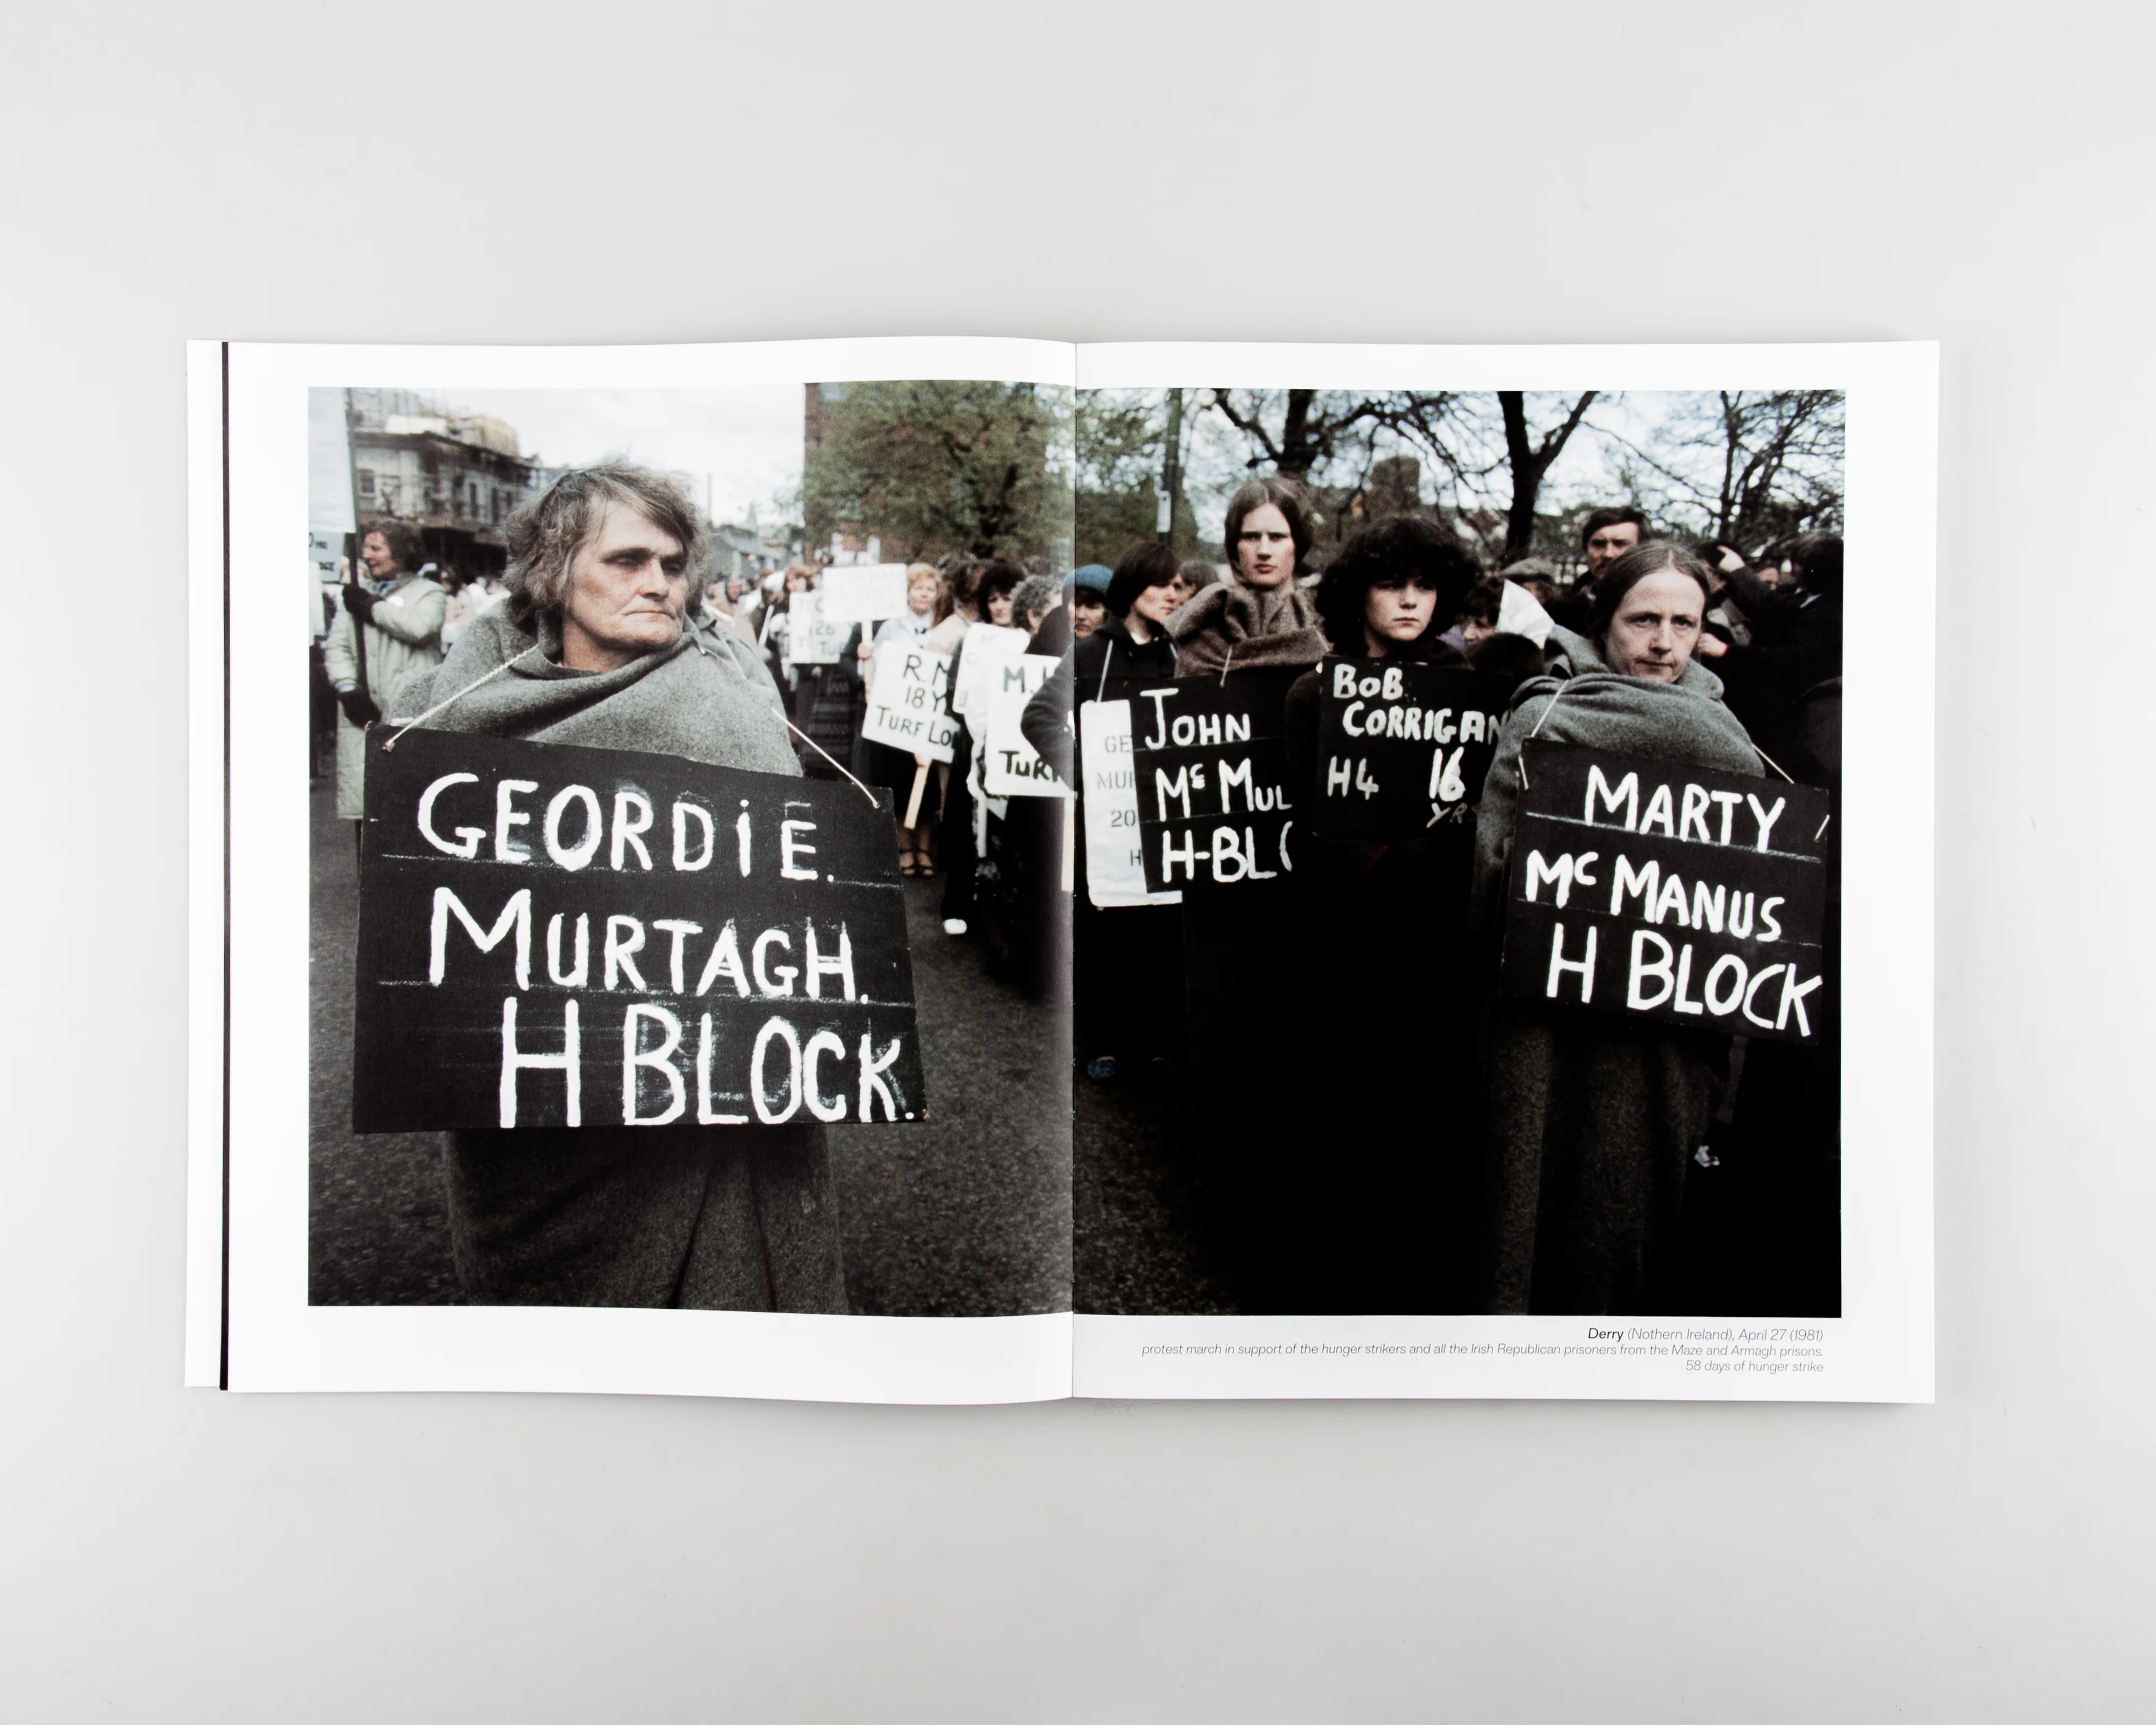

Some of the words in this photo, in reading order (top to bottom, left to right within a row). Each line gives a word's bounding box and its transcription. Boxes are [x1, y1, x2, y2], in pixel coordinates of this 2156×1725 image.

[876, 705, 924, 737] TURF
[1140, 688, 1251, 750] JOHN
[1342, 700, 1505, 745] CORRIGAN
[1429, 746, 1467, 802] 16
[1110, 809, 1137, 828] 20
[1585, 765, 1786, 854] MARTY
[1609, 854, 1785, 943] MANUS
[1546, 922, 1598, 1005] H
[1627, 929, 1823, 1037] BLOCK
[499, 995, 581, 1128] H
[1142, 1345, 1182, 1357] protest
[1186, 1343, 1222, 1354] march
[1225, 1344, 1235, 1354] in
[1238, 1345, 1283, 1357] support
[1285, 1343, 1298, 1354] of
[1300, 1343, 1319, 1354] the
[1321, 1343, 1363, 1357] hunger
[1365, 1343, 1406, 1354] strikers
[1409, 1343, 1432, 1354] and
[1433, 1343, 1446, 1354] all
[1449, 1343, 1468, 1354] the
[1471, 1343, 1494, 1354] Irish
[1497, 1343, 1561, 1357] Republican
[1563, 1345, 1617, 1357] prisoners
[1620, 1343, 1646, 1355] from
[1649, 1344, 1669, 1356] the
[1671, 1344, 1703, 1356] Maze
[1705, 1345, 1728, 1356] and
[1730, 1345, 1776, 1359] Armagh
[1779, 1346, 1824, 1359] prisons.
[1587, 1327, 1624, 1343] Derry
[1627, 1327, 1683, 1341] (Nothern
[1686, 1328, 1734, 1342] Ireland),
[1737, 1329, 1768, 1343] April
[1770, 1329, 1787, 1340] 27
[1789, 1329, 1824, 1343] (1981)
[1686, 1359, 1701, 1372] 58
[1704, 1360, 1731, 1374] days
[1734, 1360, 1746, 1372] of
[1748, 1361, 1789, 1375] hunger
[1792, 1361, 1824, 1372] strike
